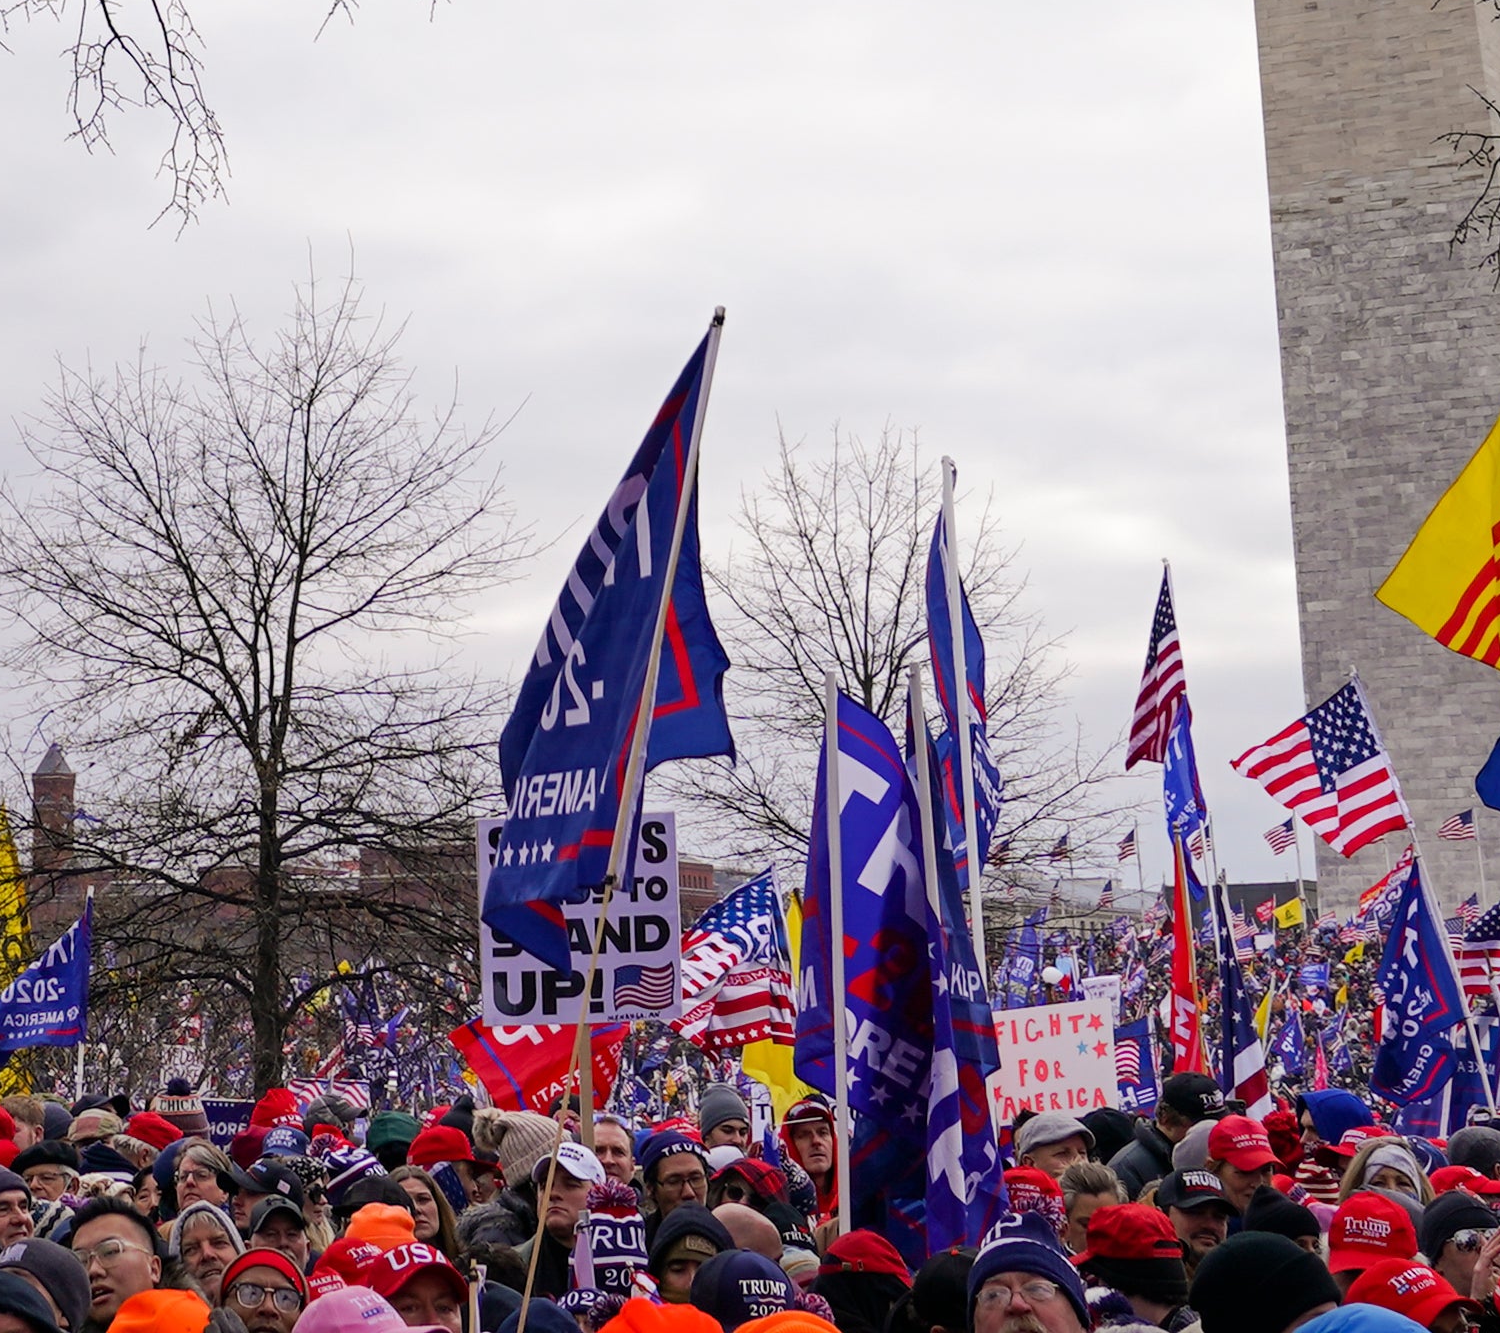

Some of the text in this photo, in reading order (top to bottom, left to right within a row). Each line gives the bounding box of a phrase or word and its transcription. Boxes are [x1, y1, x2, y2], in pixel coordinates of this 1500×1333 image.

[630, 876, 668, 903] TO
[492, 969, 605, 1016] UP!
[994, 1014, 1084, 1045] FIGHT
[1018, 1059, 1065, 1087] FOR
[1003, 1087, 1106, 1120] AMERICA
[1343, 1216, 1391, 1238] Trump
[738, 1279, 787, 1296] TRUMP
[749, 1303, 785, 1317] 2020
